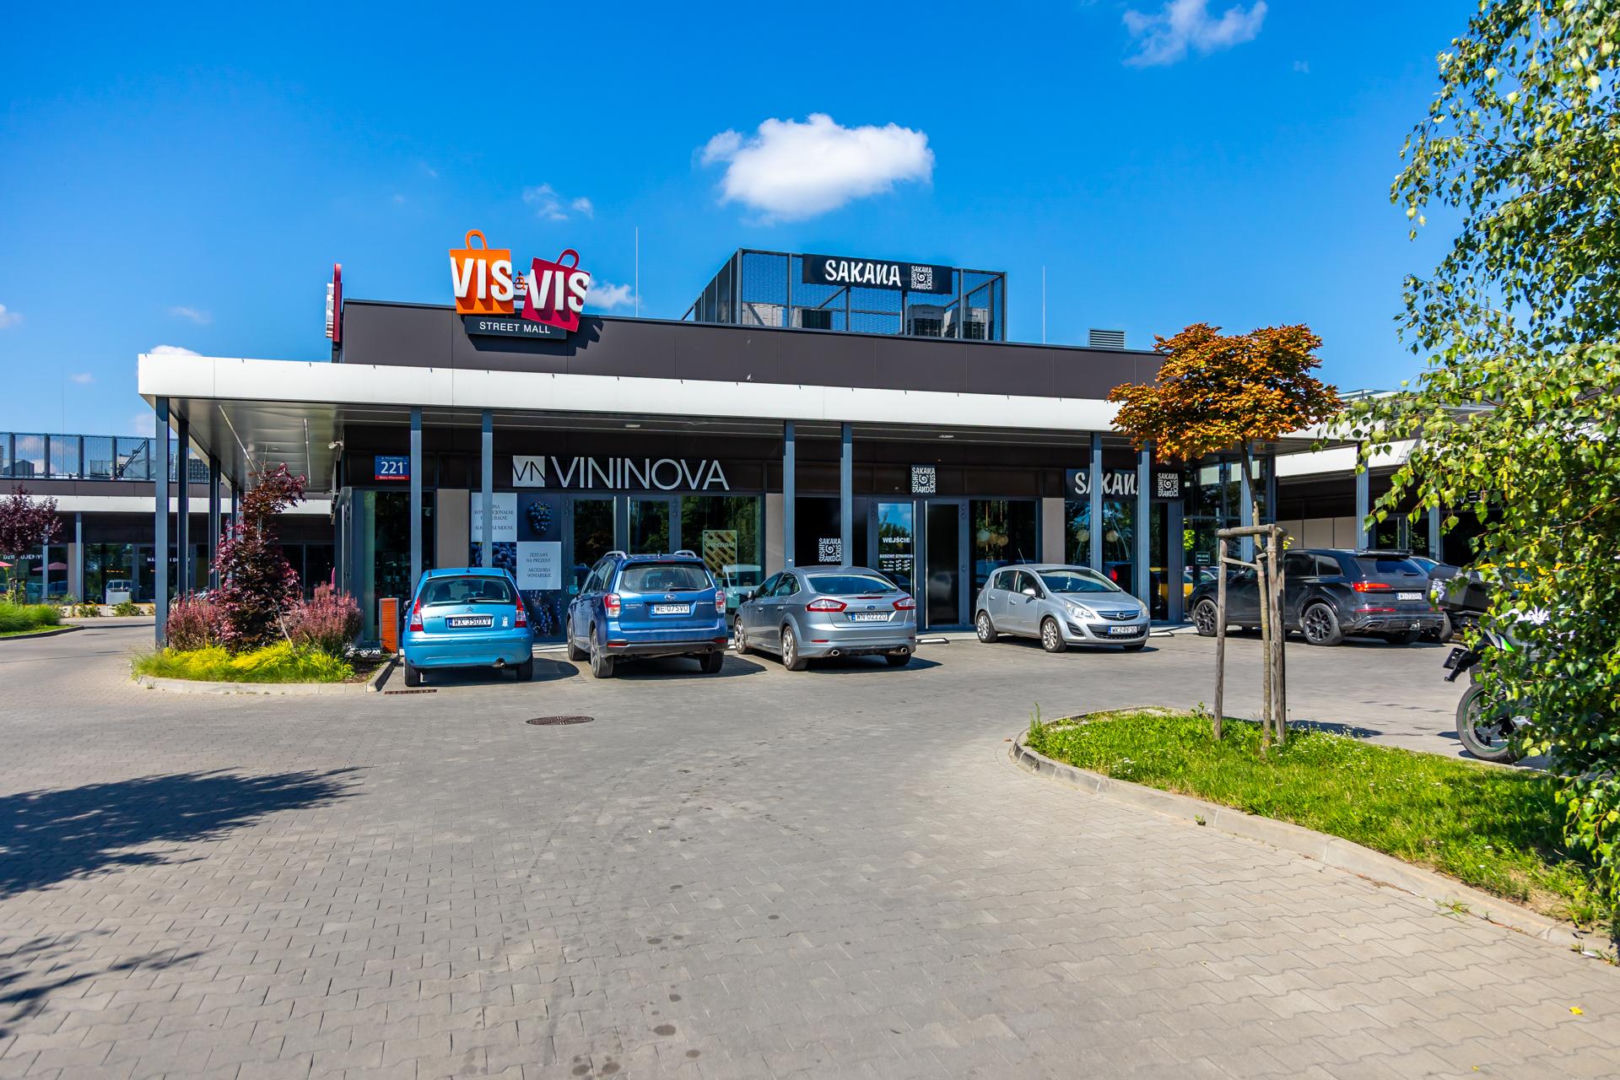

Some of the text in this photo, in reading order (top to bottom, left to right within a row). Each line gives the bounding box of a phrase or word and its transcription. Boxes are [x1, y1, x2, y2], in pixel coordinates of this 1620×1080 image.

[449, 256, 514, 302] VIS
[529, 269, 591, 314] VIS
[479, 321, 551, 334] STREET MALL
[381, 461, 403, 474] 221
[550, 455, 730, 491] VININOVA
